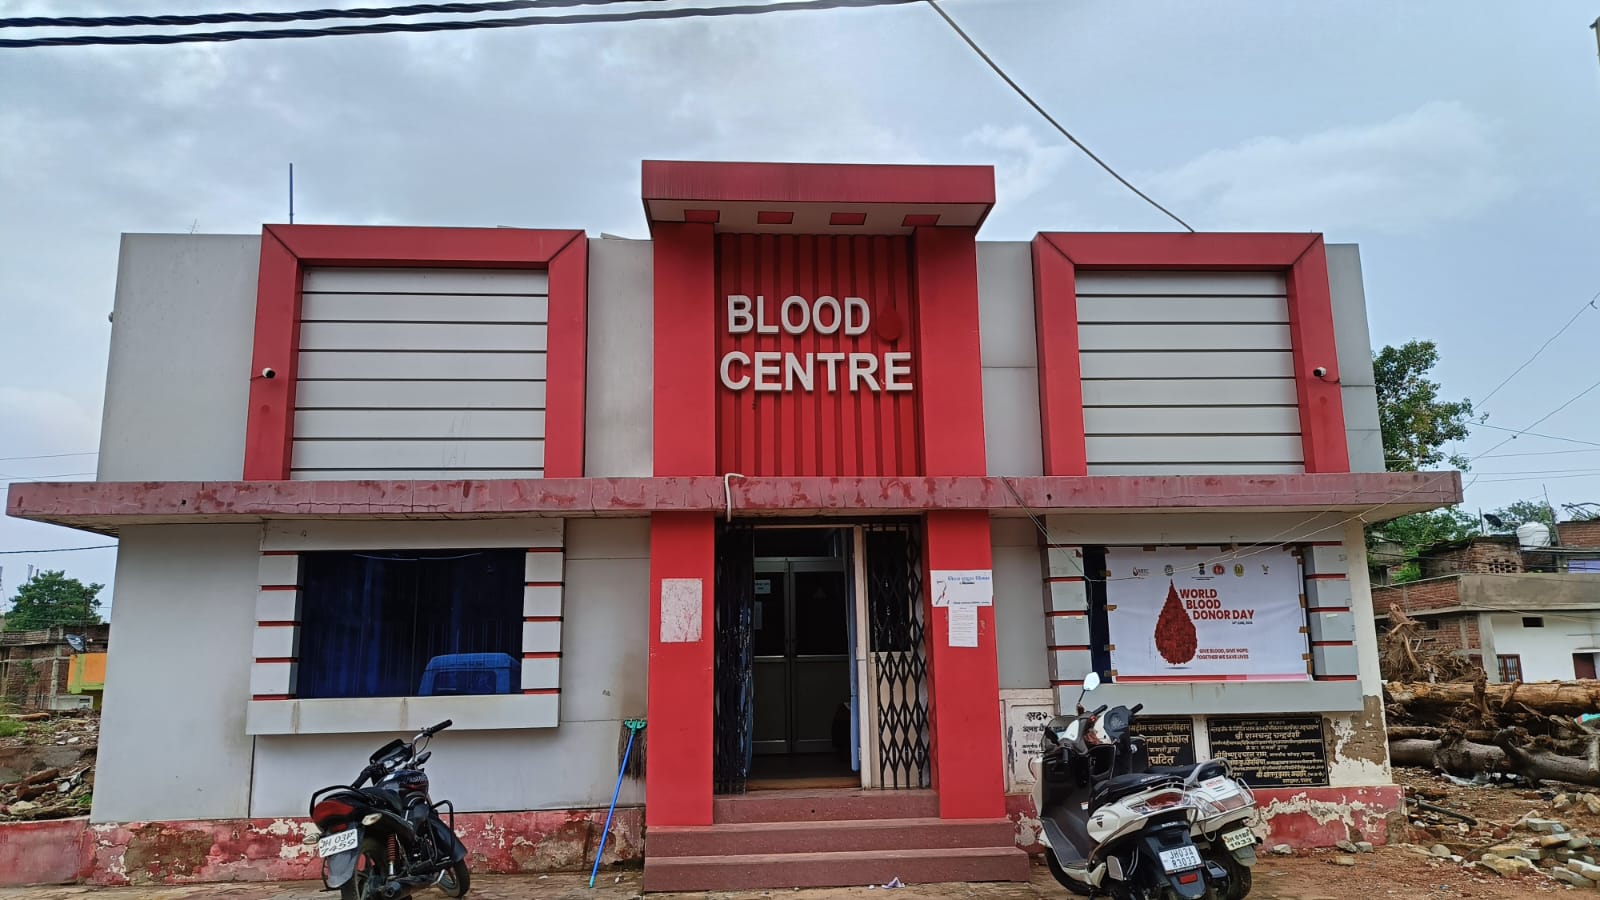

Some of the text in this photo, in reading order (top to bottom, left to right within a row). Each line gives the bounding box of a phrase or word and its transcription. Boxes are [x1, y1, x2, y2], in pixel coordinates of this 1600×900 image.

[727, 295, 870, 336] BLOOD
[720, 351, 913, 392] CENTRE
[1180, 588, 1218, 598] WORLD
[1186, 600, 1221, 609] BLOOD
[1193, 610, 1254, 620] DONOR DAY
[1170, 848, 1194, 860] JH03A
